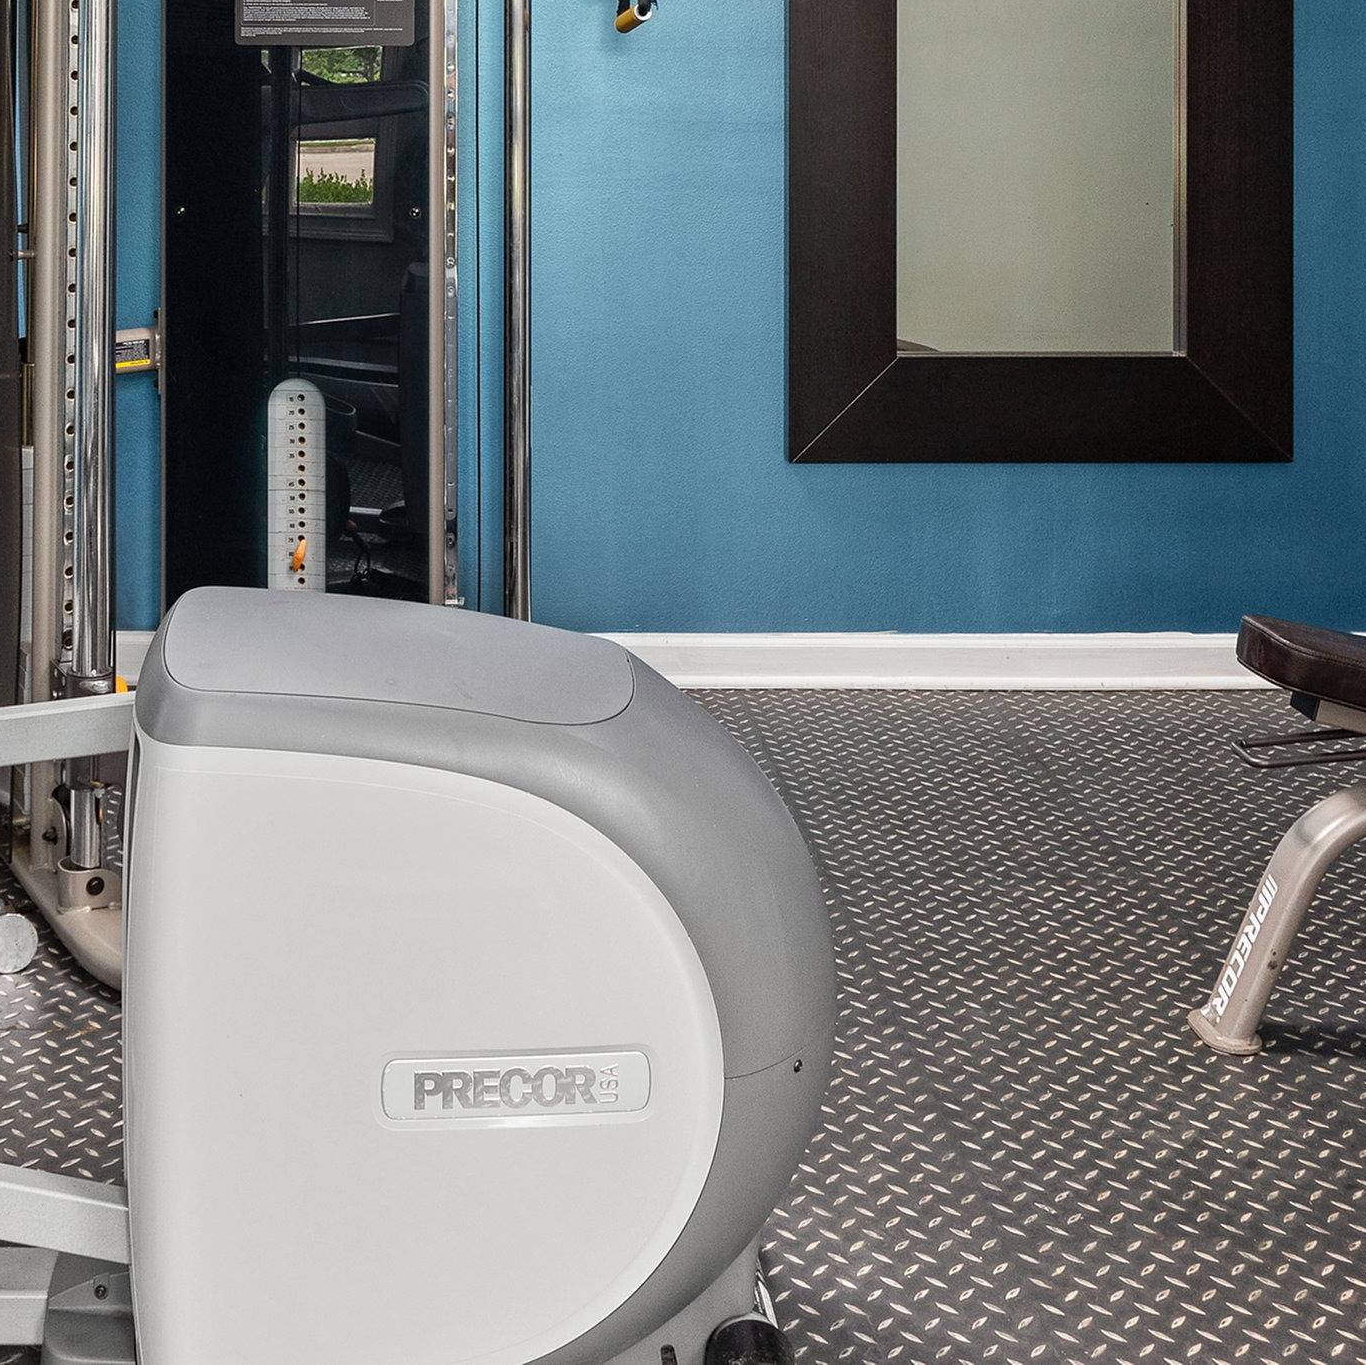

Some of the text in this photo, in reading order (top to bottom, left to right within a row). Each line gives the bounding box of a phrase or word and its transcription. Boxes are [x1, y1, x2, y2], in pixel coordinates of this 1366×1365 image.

[1212, 879, 1278, 1017] PRECOR
[413, 1062, 620, 1112] PRECOR USA
